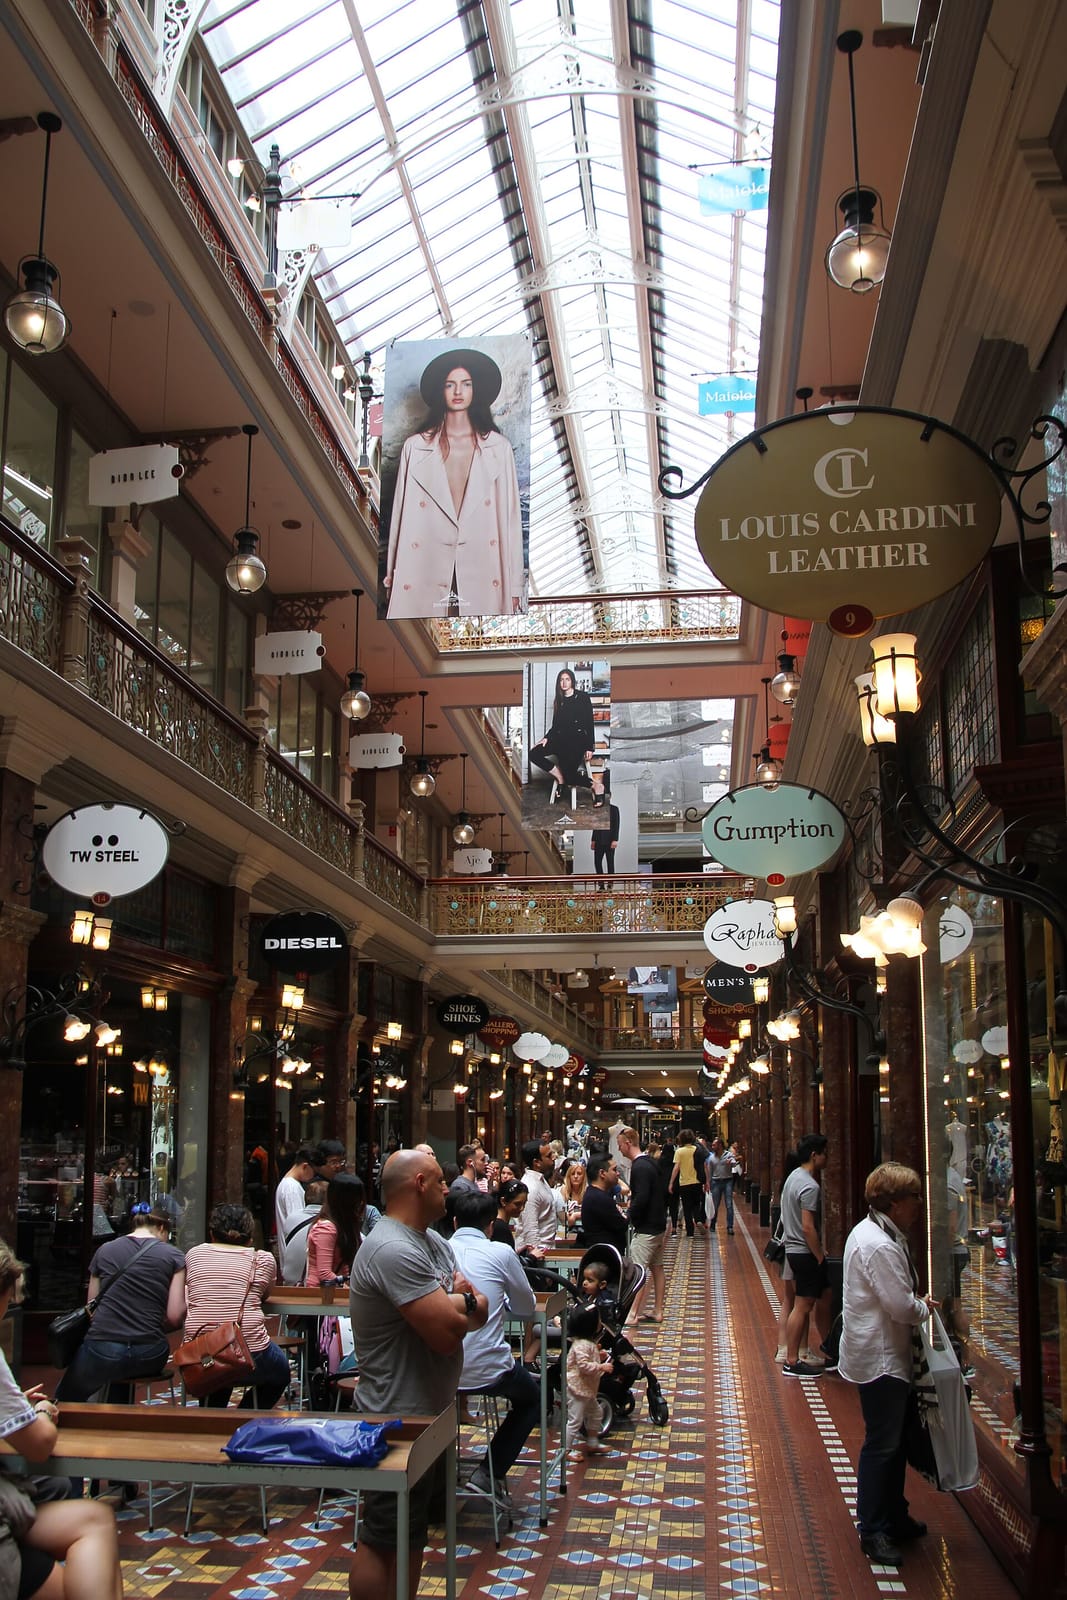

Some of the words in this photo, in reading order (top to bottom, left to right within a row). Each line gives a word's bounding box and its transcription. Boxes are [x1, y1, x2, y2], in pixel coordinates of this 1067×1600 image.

[719, 512, 819, 542] LOUIS
[829, 502, 977, 535] CARDINI
[767, 542, 931, 575] LEATHER
[845, 612, 856, 627] 9
[713, 815, 835, 845] Gumption
[69, 850, 92, 863] TW
[95, 850, 139, 863] STEEL
[711, 922, 777, 951] Rapha
[264, 937, 342, 950] DIESEL
[706, 977, 745, 988] MEN'S
[448, 1003, 477, 1014] SHOE
[707, 1006, 755, 1015] SHOPNG
[442, 1013, 481, 1023] SHINES
